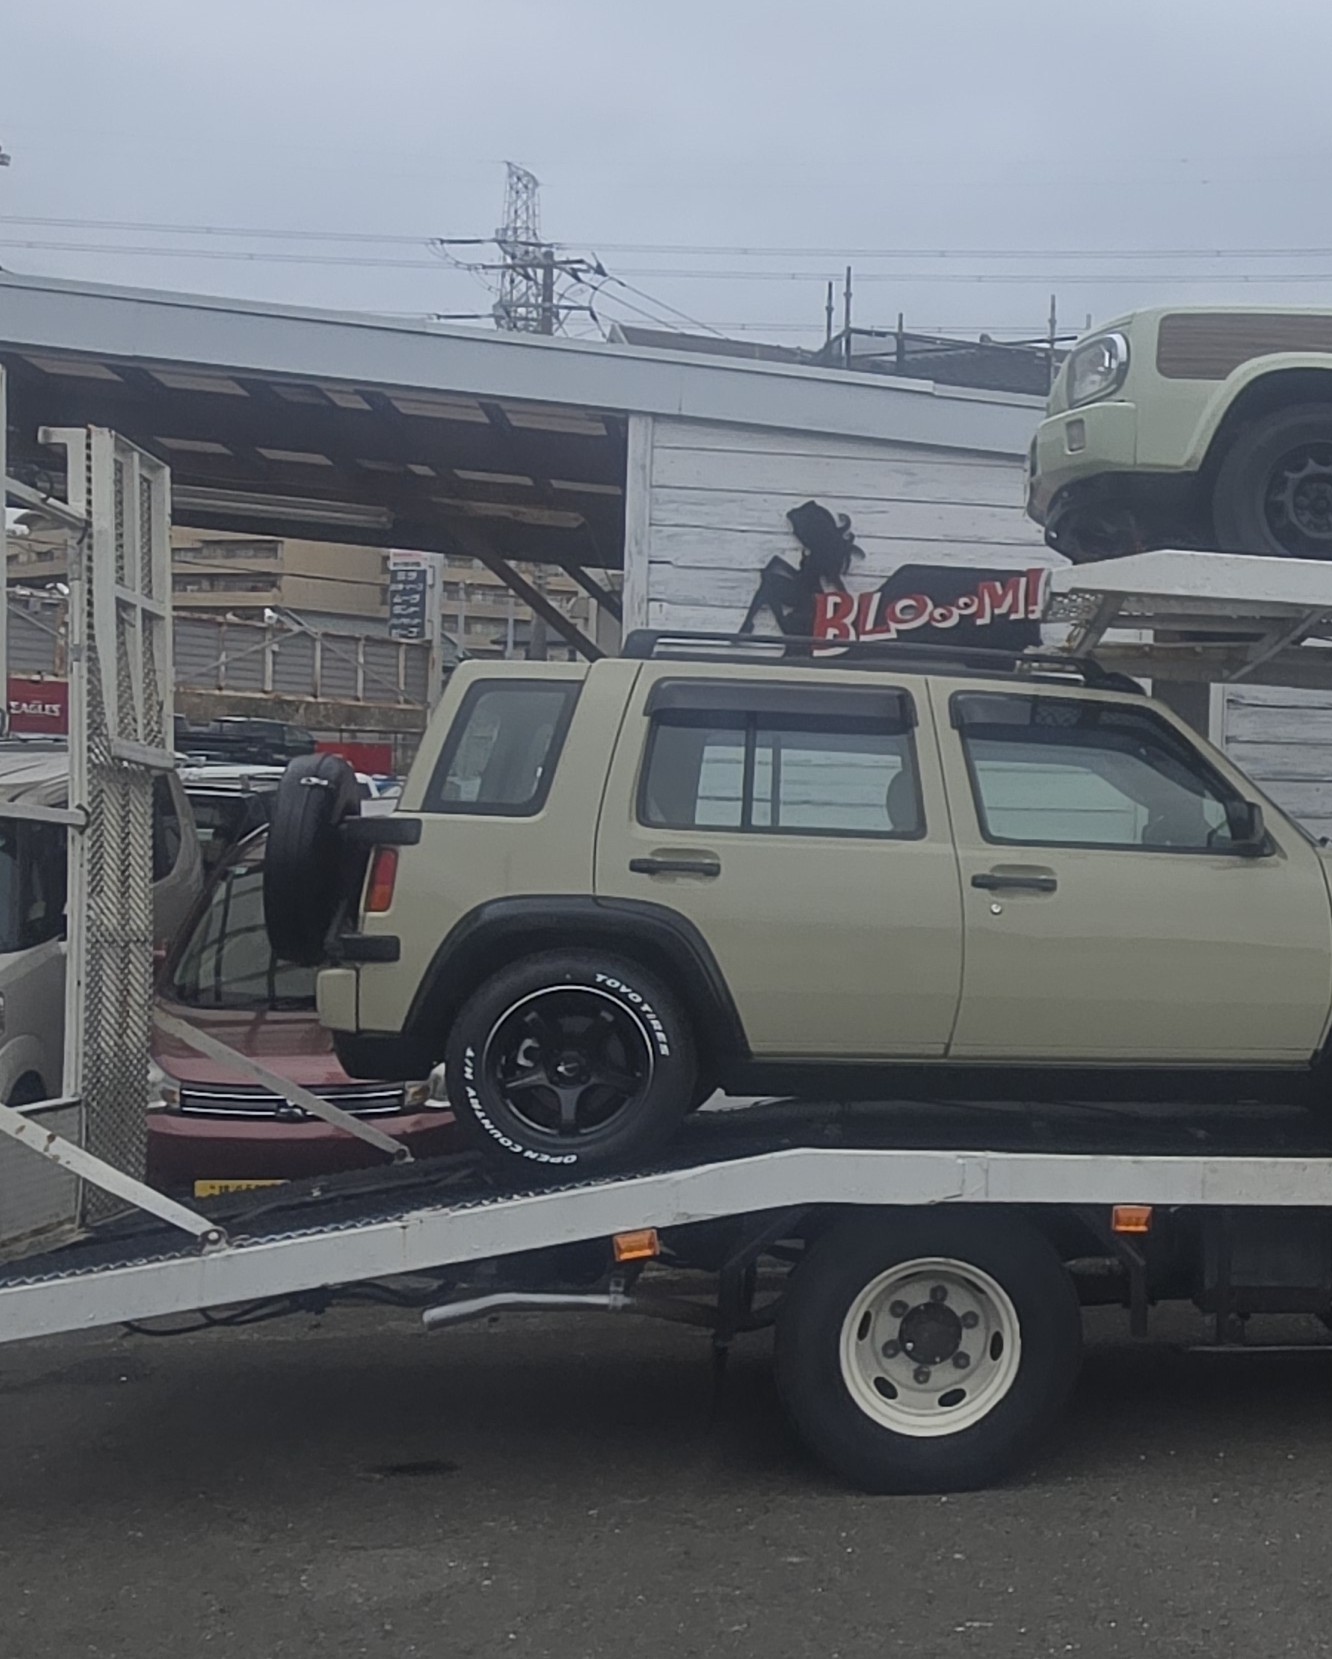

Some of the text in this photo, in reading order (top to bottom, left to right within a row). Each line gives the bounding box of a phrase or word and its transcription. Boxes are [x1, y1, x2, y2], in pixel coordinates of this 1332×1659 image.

[595, 973, 670, 1056] TOYO TIRES
[465, 1086, 523, 1153] COUNTRY
[523, 1152, 577, 1164] OPEN
